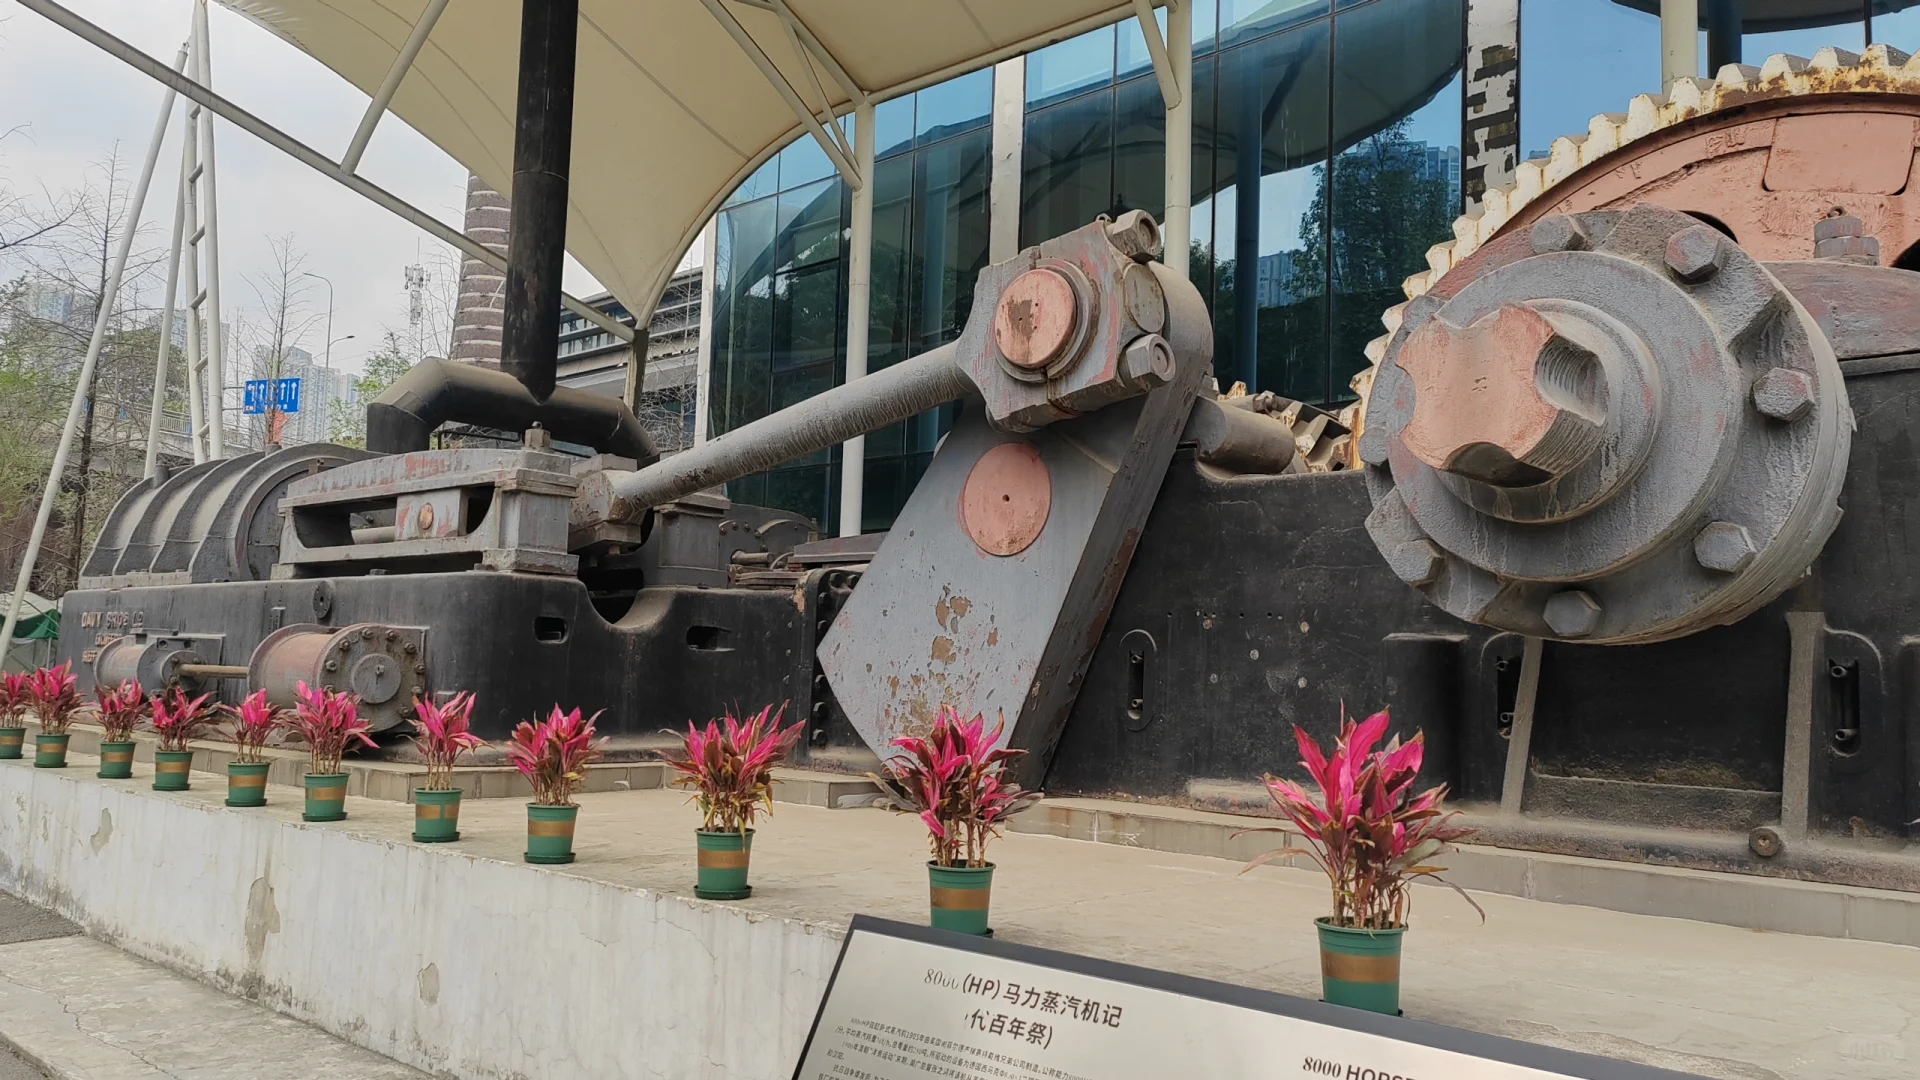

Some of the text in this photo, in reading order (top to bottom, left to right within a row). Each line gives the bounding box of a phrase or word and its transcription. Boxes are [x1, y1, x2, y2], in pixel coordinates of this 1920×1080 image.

[1002, 982, 1123, 1028] 马力蒸汽机记
[1302, 1056, 1342, 1078] 8000
